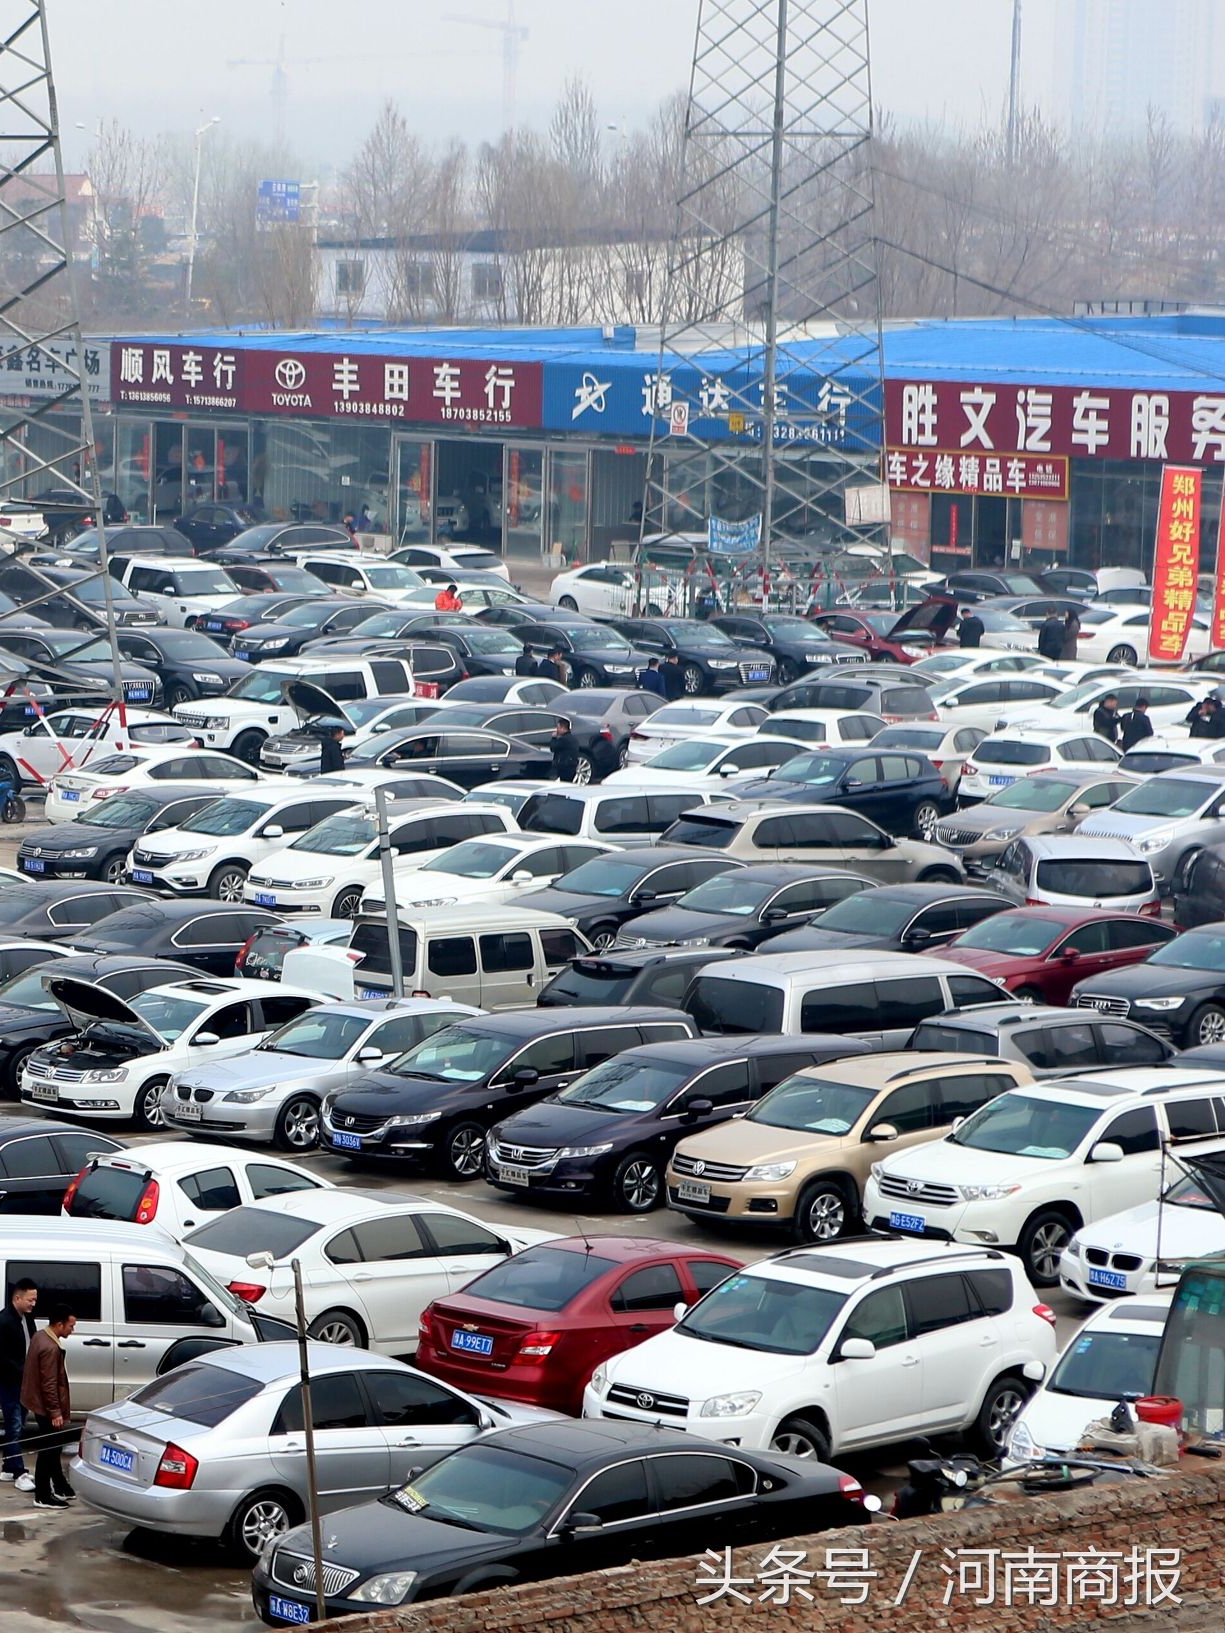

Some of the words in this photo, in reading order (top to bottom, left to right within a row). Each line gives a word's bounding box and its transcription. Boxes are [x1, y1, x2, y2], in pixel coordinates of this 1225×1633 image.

[120, 347, 236, 391] 顺风车行
[332, 357, 516, 409] 丰田车行
[272, 393, 313, 408] TOYOTA
[334, 401, 405, 418] 13903848802
[440, 406, 512, 423] 18703852155
[902, 383, 1225, 462] 胜文汽车服务
[888, 451, 1026, 494] 车之缘精品车
[1158, 474, 1196, 656] 郑州好兄弟精品车
